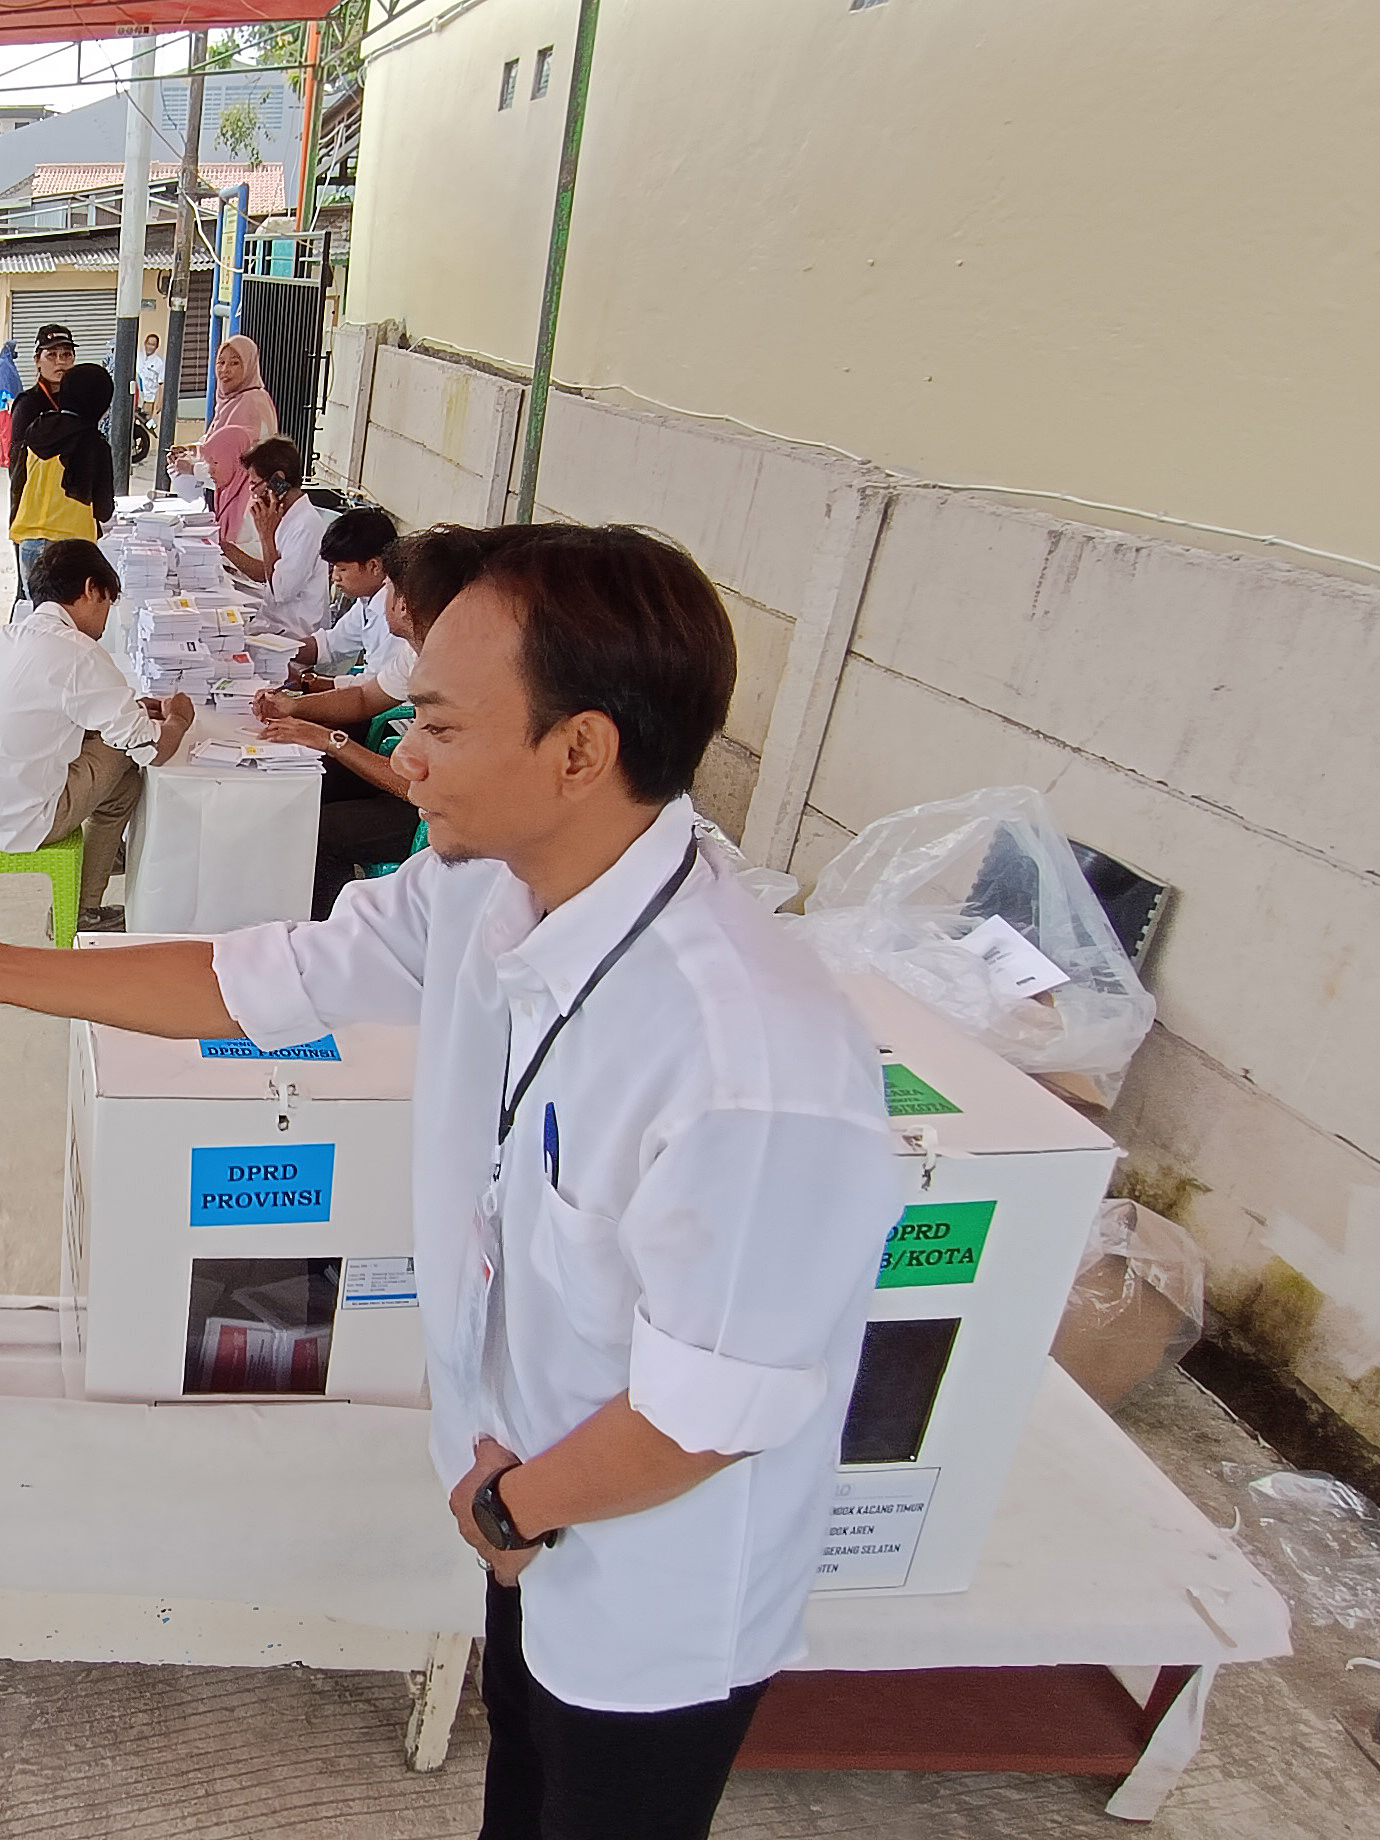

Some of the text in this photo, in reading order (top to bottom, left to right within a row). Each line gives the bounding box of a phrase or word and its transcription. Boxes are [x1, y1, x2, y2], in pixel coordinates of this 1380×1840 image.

[207, 1046, 253, 1057] DPRD
[227, 1163, 298, 1183] DPRD
[201, 1189, 323, 1210] PROVINSI
[880, 1247, 975, 1270] B/KOTA
[856, 1504, 894, 1515] KACANG
[895, 1502, 925, 1513] TIMUR
[849, 1525, 875, 1536] AREN
[860, 1543, 901, 1555] SELATAN
